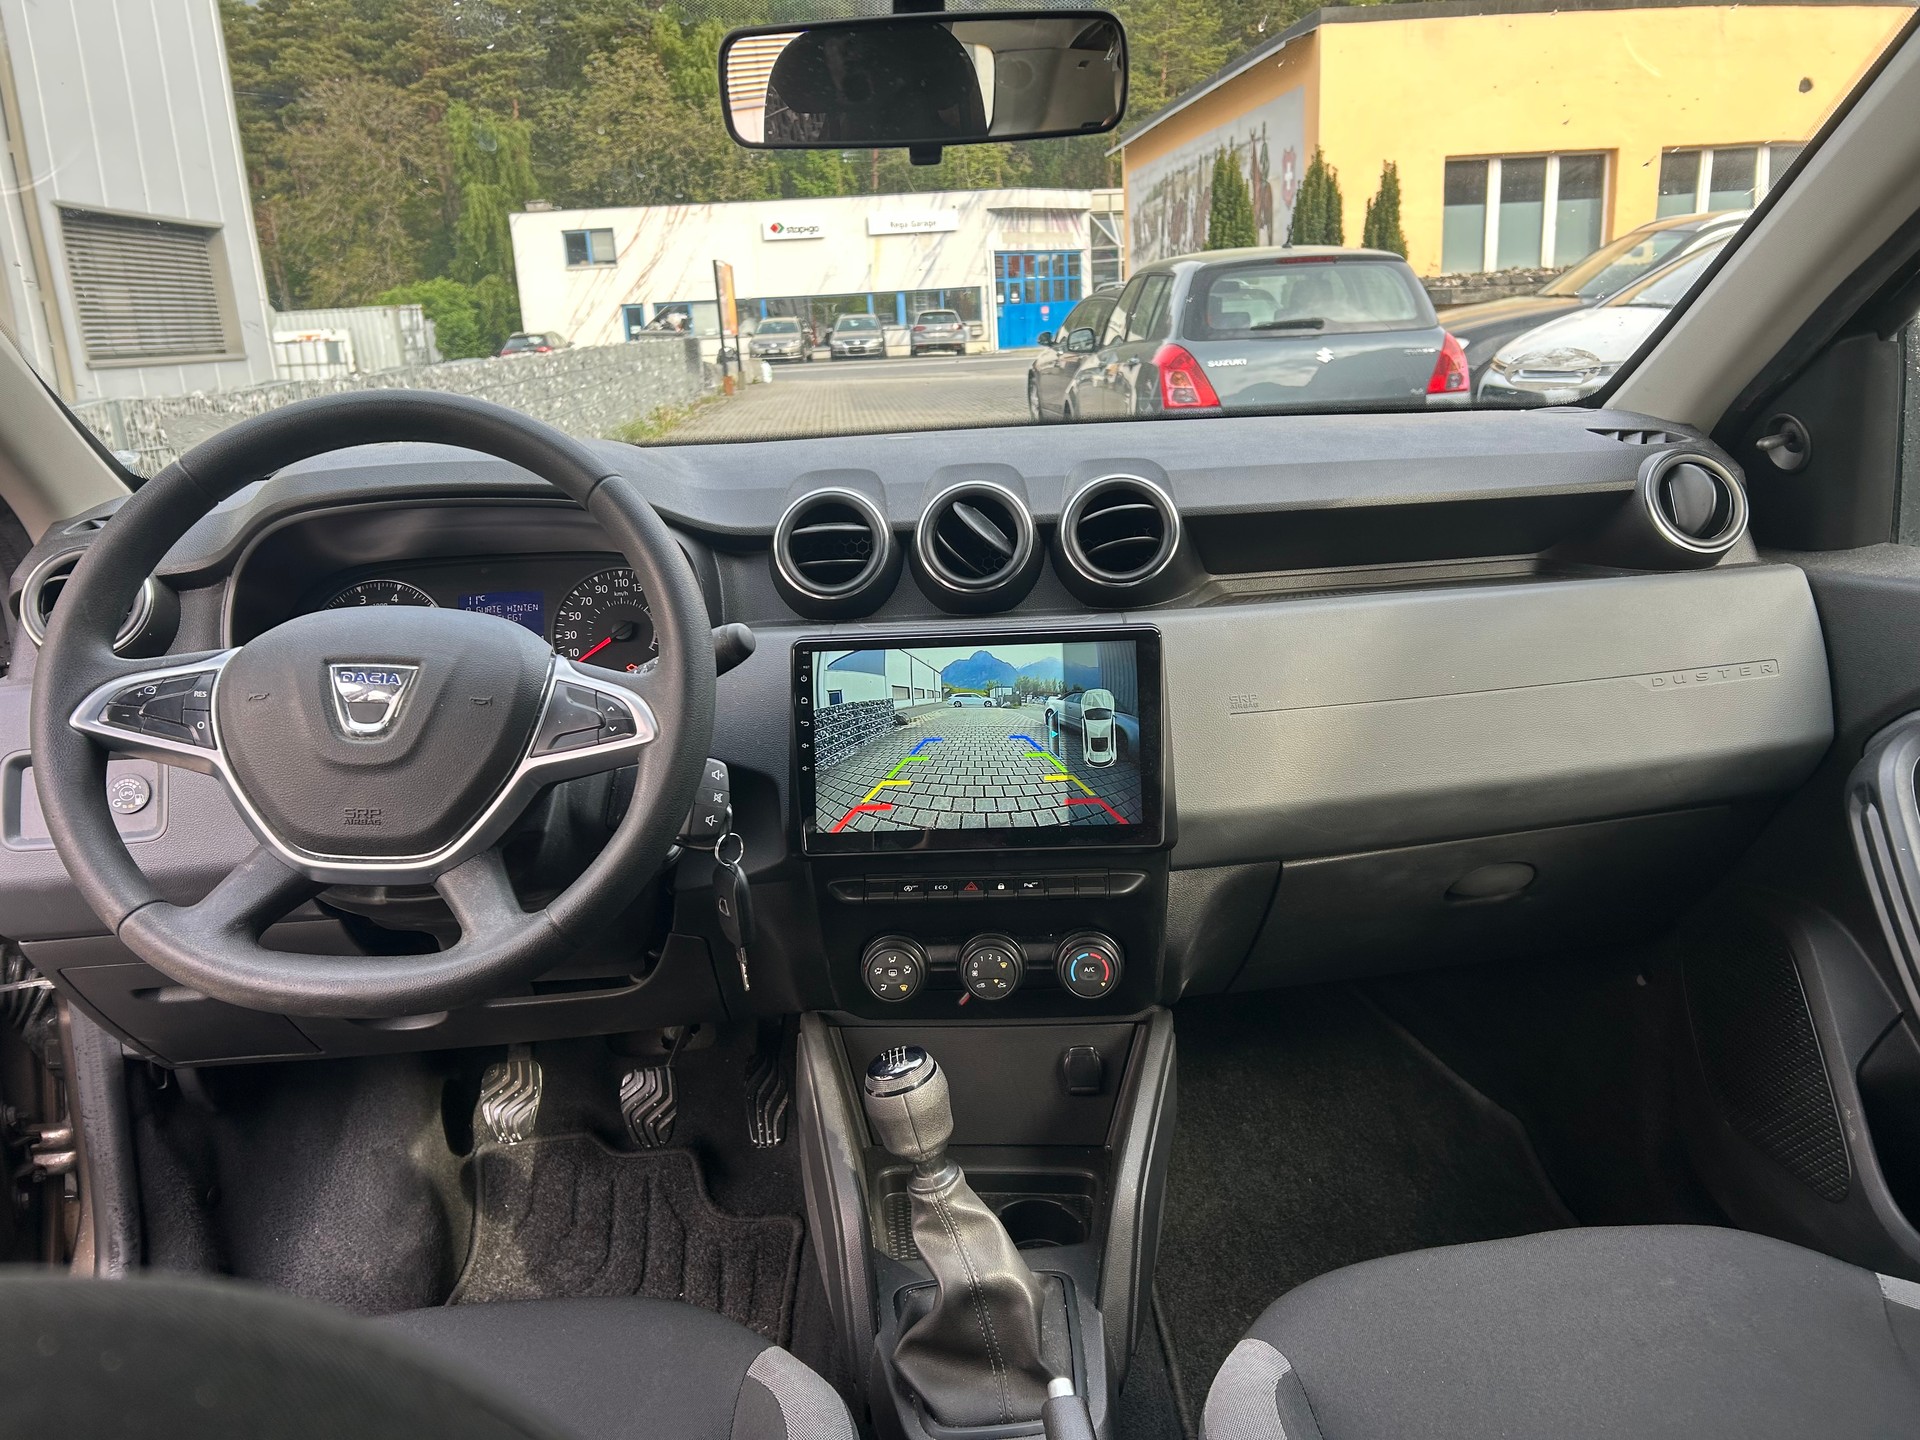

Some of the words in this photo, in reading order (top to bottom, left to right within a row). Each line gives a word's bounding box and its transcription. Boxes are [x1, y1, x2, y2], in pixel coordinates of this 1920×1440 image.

[1207, 358, 1247, 368] SUZUKI
[613, 578, 629, 588] 110
[632, 583, 643, 592] 13
[594, 584, 608, 594] 90
[359, 595, 367, 605] 3
[390, 593, 399, 603] 4
[580, 596, 593, 606] 70
[507, 603, 539, 613] HINTEN
[568, 611, 582, 621] 50
[564, 630, 578, 640] 30
[568, 647, 580, 657] 10
[340, 671, 402, 686] DACIA
[1651, 664, 1774, 688] DUSTER
[193, 690, 208, 698] RES
[344, 808, 382, 819] SRP
